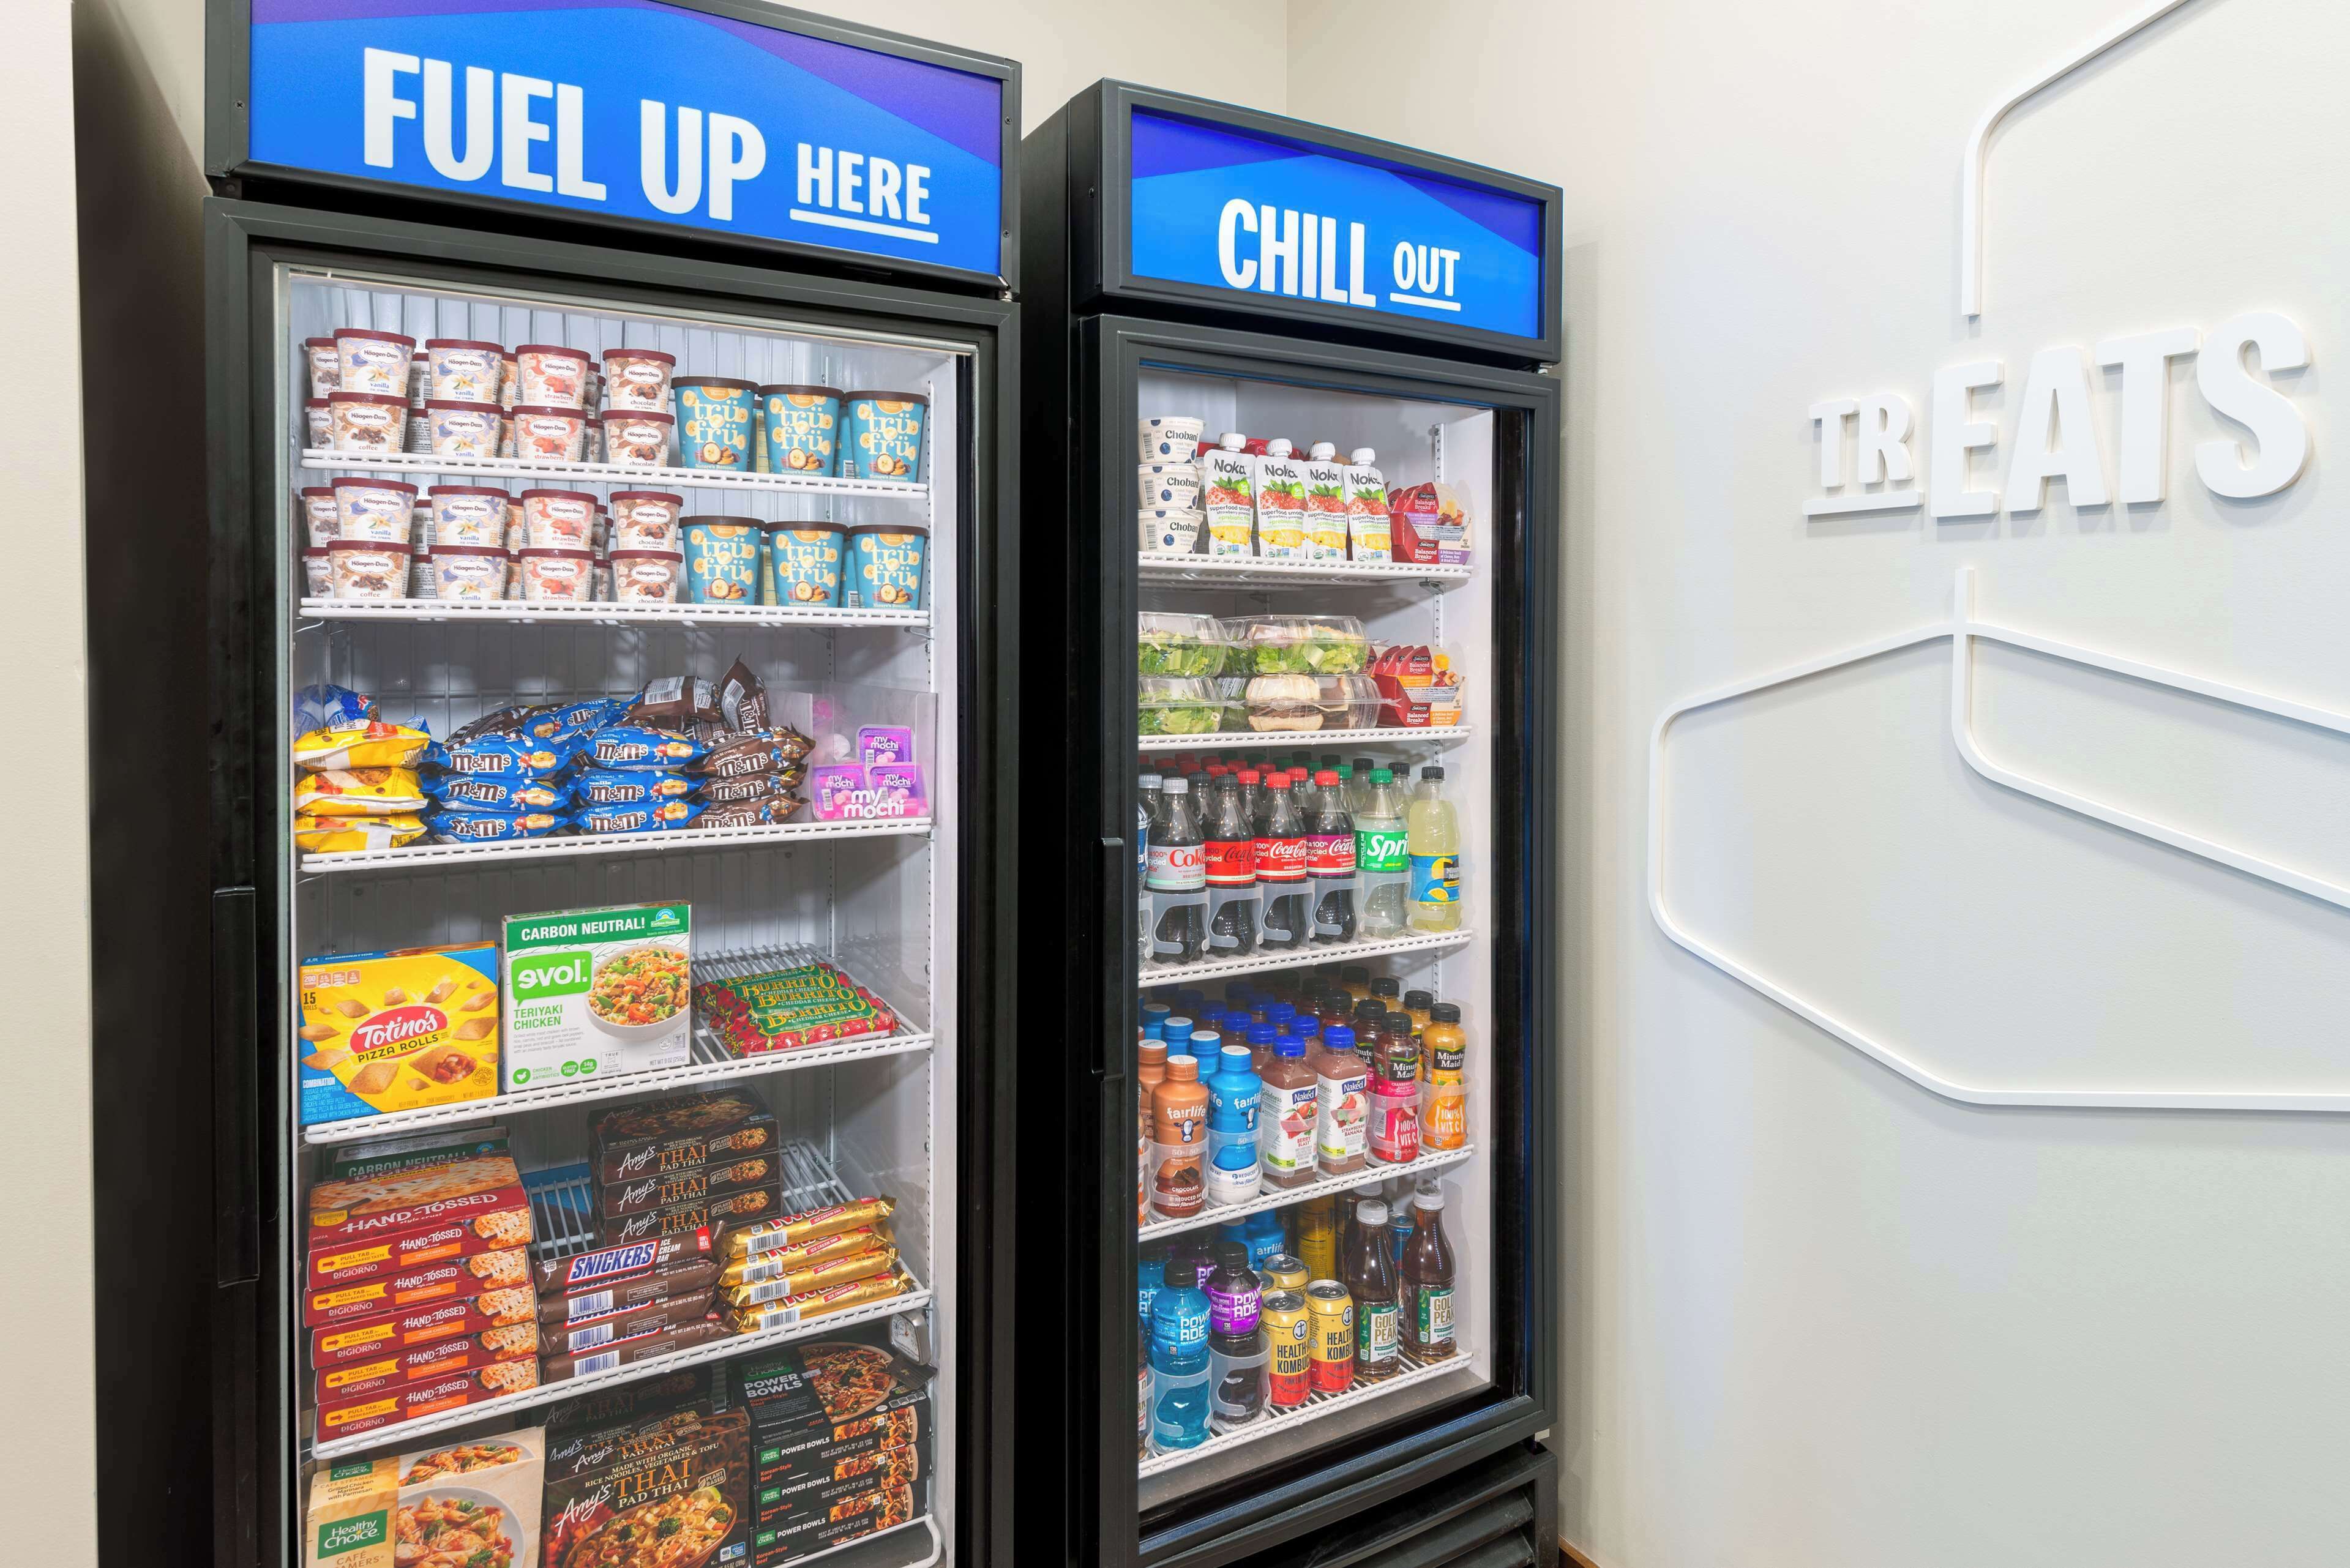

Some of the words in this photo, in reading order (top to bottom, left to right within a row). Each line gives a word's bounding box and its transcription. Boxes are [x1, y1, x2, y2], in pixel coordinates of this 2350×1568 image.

[364, 47, 607, 201] FUEL
[641, 99, 766, 222] UP
[797, 143, 930, 225] HERE
[1218, 198, 1376, 308] CHILL
[1393, 241, 1461, 296] OUT
[351, 413, 387, 421] Häagen-Dazs
[694, 399, 739, 423] trü
[694, 420, 739, 445] frü
[1165, 430, 1198, 442] Chobani
[1214, 458, 1246, 475] Noka
[364, 497, 400, 507] Häagen-Dazs
[594, 741, 649, 761] m&m's
[870, 741, 899, 750] mochi
[826, 780, 855, 788] mochi
[883, 778, 911, 787] mochi
[587, 784, 645, 802] m&m's
[589, 811, 646, 832] m&m's
[1367, 832, 1409, 862] Spri
[522, 923, 577, 941] CARBON
[582, 917, 645, 935] NEUTRAL!
[741, 975, 836, 996] BURRITO
[303, 992, 316, 1004] 15
[514, 1004, 563, 1018] TERIYAKI
[357, 1010, 438, 1049] Totino's
[514, 1016, 561, 1030] CHICKEN
[358, 1047, 395, 1063] PIZZA
[400, 1034, 439, 1051] ROLLS
[1437, 1051, 1464, 1060] Minute
[1393, 1062, 1417, 1072] Minut
[1441, 1059, 1461, 1068] Maid
[1343, 1080, 1364, 1092] Naked
[1293, 1089, 1315, 1102] Naked
[1341, 1124, 1365, 1133] STRAWBERRY
[1400, 1120, 1416, 1132] 100%
[1441, 1121, 1454, 1133] VIT
[1400, 1134, 1411, 1146] VIT
[1412, 1132, 1417, 1143] C
[617, 1146, 657, 1178] Amy's
[657, 1144, 708, 1165] THAI
[660, 1162, 679, 1171] PAD
[618, 1179, 657, 1212] Amy's
[657, 1176, 708, 1199] THAI
[660, 1195, 680, 1204] PAD
[618, 1211, 657, 1244] Amy's
[658, 1208, 709, 1231] THAI
[399, 1228, 462, 1251] HAND-TOSSED
[662, 1227, 681, 1236] PAD
[659, 1243, 681, 1254] CREAM
[660, 1238, 672, 1247] ICE
[340, 1252, 354, 1261] PULL
[570, 1242, 655, 1280] SNICKERS
[656, 1254, 670, 1263] BAR
[394, 1267, 458, 1290] HAND-TOSSED
[1233, 1301, 1257, 1318] ADE
[1434, 1294, 1454, 1311] GOLD
[403, 1306, 466, 1329] HAND-TOSSED
[1375, 1312, 1397, 1328] GOLD
[1434, 1310, 1454, 1324] PEAK
[1180, 1325, 1205, 1342] ADE
[1374, 1327, 1397, 1342] PEAK
[406, 1341, 470, 1364] HAND-TOSSED
[1278, 1354, 1309, 1373] KOMBUC
[744, 1373, 798, 1391] POWER
[746, 1380, 803, 1398] BOWLS
[406, 1379, 469, 1403] HAND-TOSSED
[781, 1443, 806, 1456] POWER
[806, 1436, 830, 1450] BOWLS
[585, 1477, 604, 1488] RICE
[605, 1466, 643, 1482] NOODLES,
[644, 1452, 690, 1470] VEGETABLES
[699, 1442, 719, 1453] TOFU
[612, 1462, 634, 1474] MADE
[635, 1455, 657, 1466] WITH
[657, 1444, 693, 1461] ORGANIC
[614, 1458, 691, 1499] THAI
[705, 1469, 724, 1481] PLANT
[760, 1463, 792, 1477] Korean-Style
[327, 1484, 348, 1493] Grilled
[349, 1479, 374, 1489] Chicken
[706, 1475, 725, 1487] BASED
[782, 1482, 806, 1496] POWER
[807, 1476, 831, 1490] BOWLS
[337, 1486, 364, 1495] Marinara
[342, 1487, 373, 1498] Parmesan
[618, 1492, 648, 1509] PAD
[651, 1479, 689, 1498] THAI
[555, 1484, 612, 1538] Amy's
[331, 1520, 377, 1537] Healthy
[324, 1528, 378, 1549] Choice
[337, 1550, 367, 1565] CAFÉ
